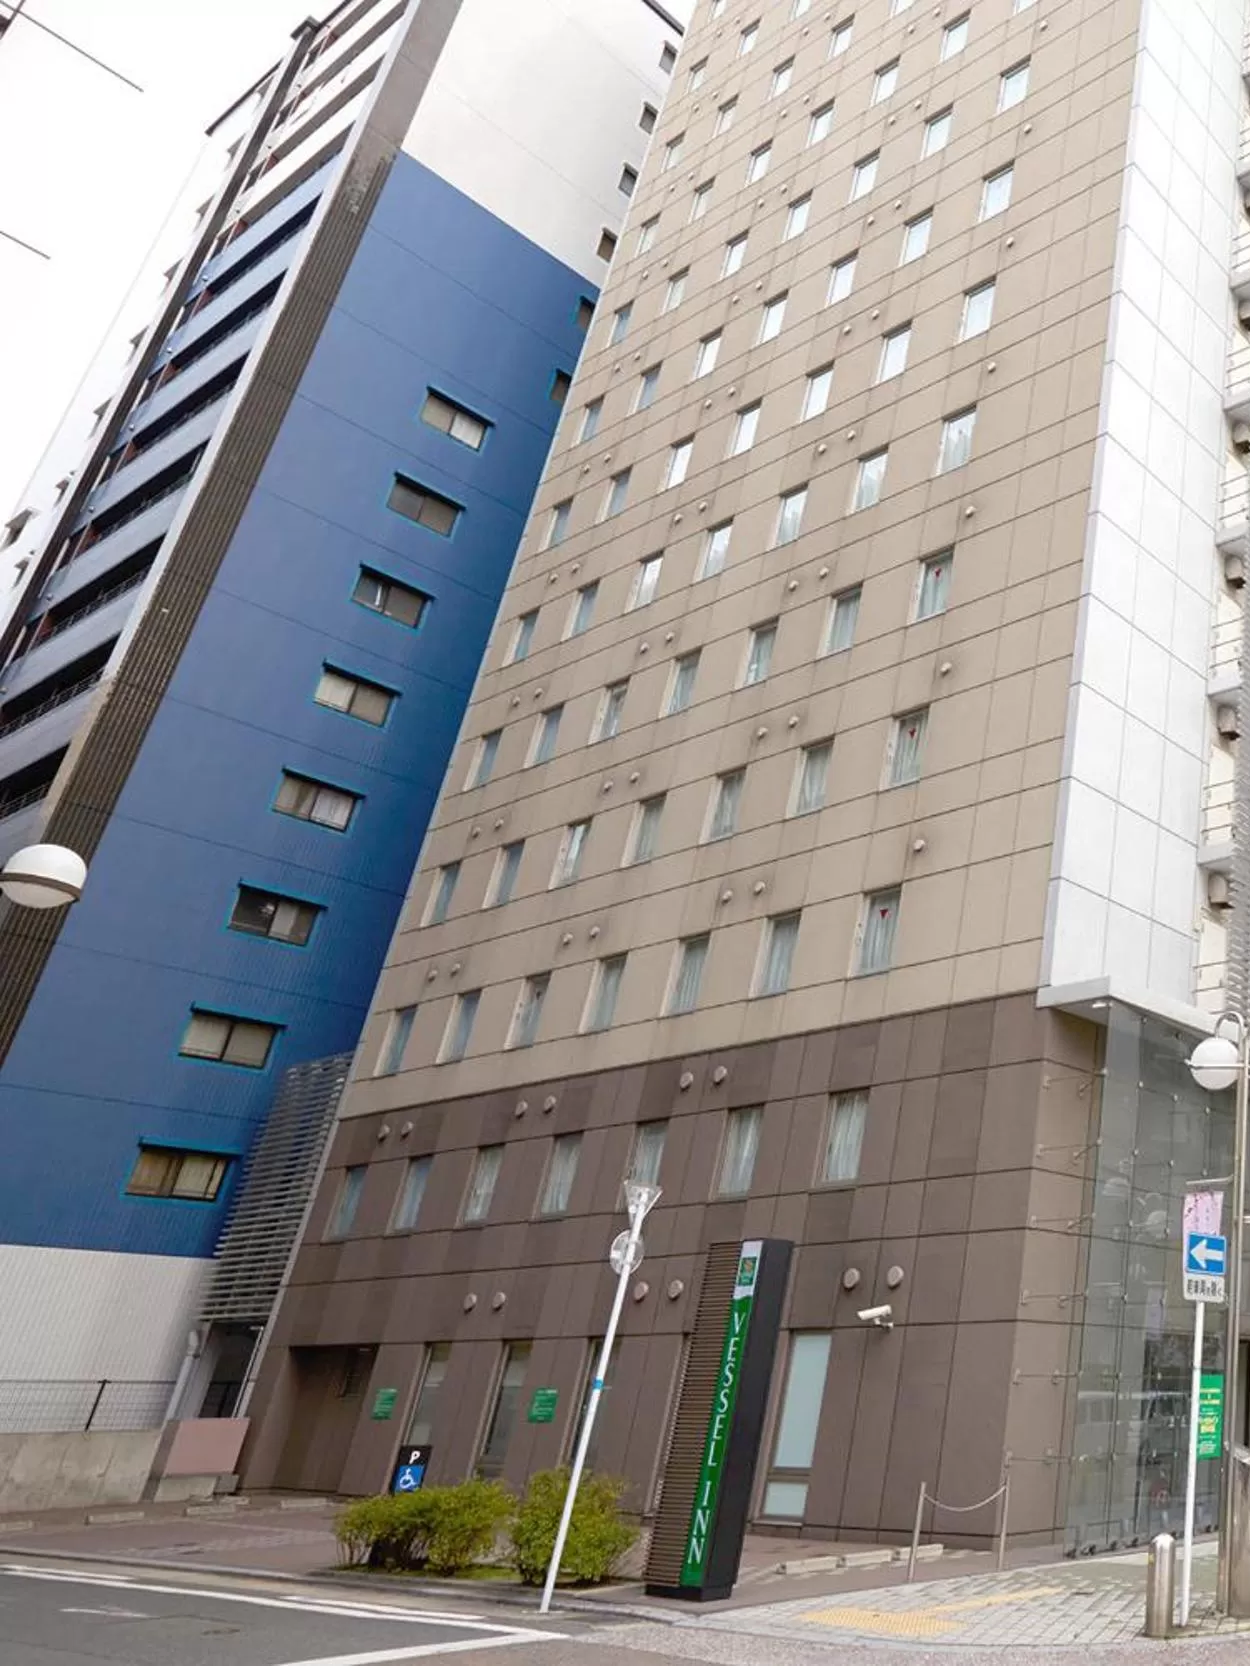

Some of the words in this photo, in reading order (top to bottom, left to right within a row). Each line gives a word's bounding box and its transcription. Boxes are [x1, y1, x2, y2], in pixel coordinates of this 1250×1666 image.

[707, 1311, 746, 1467] VESSEL
[409, 1450, 421, 1464] P
[688, 1480, 711, 1564] INN
